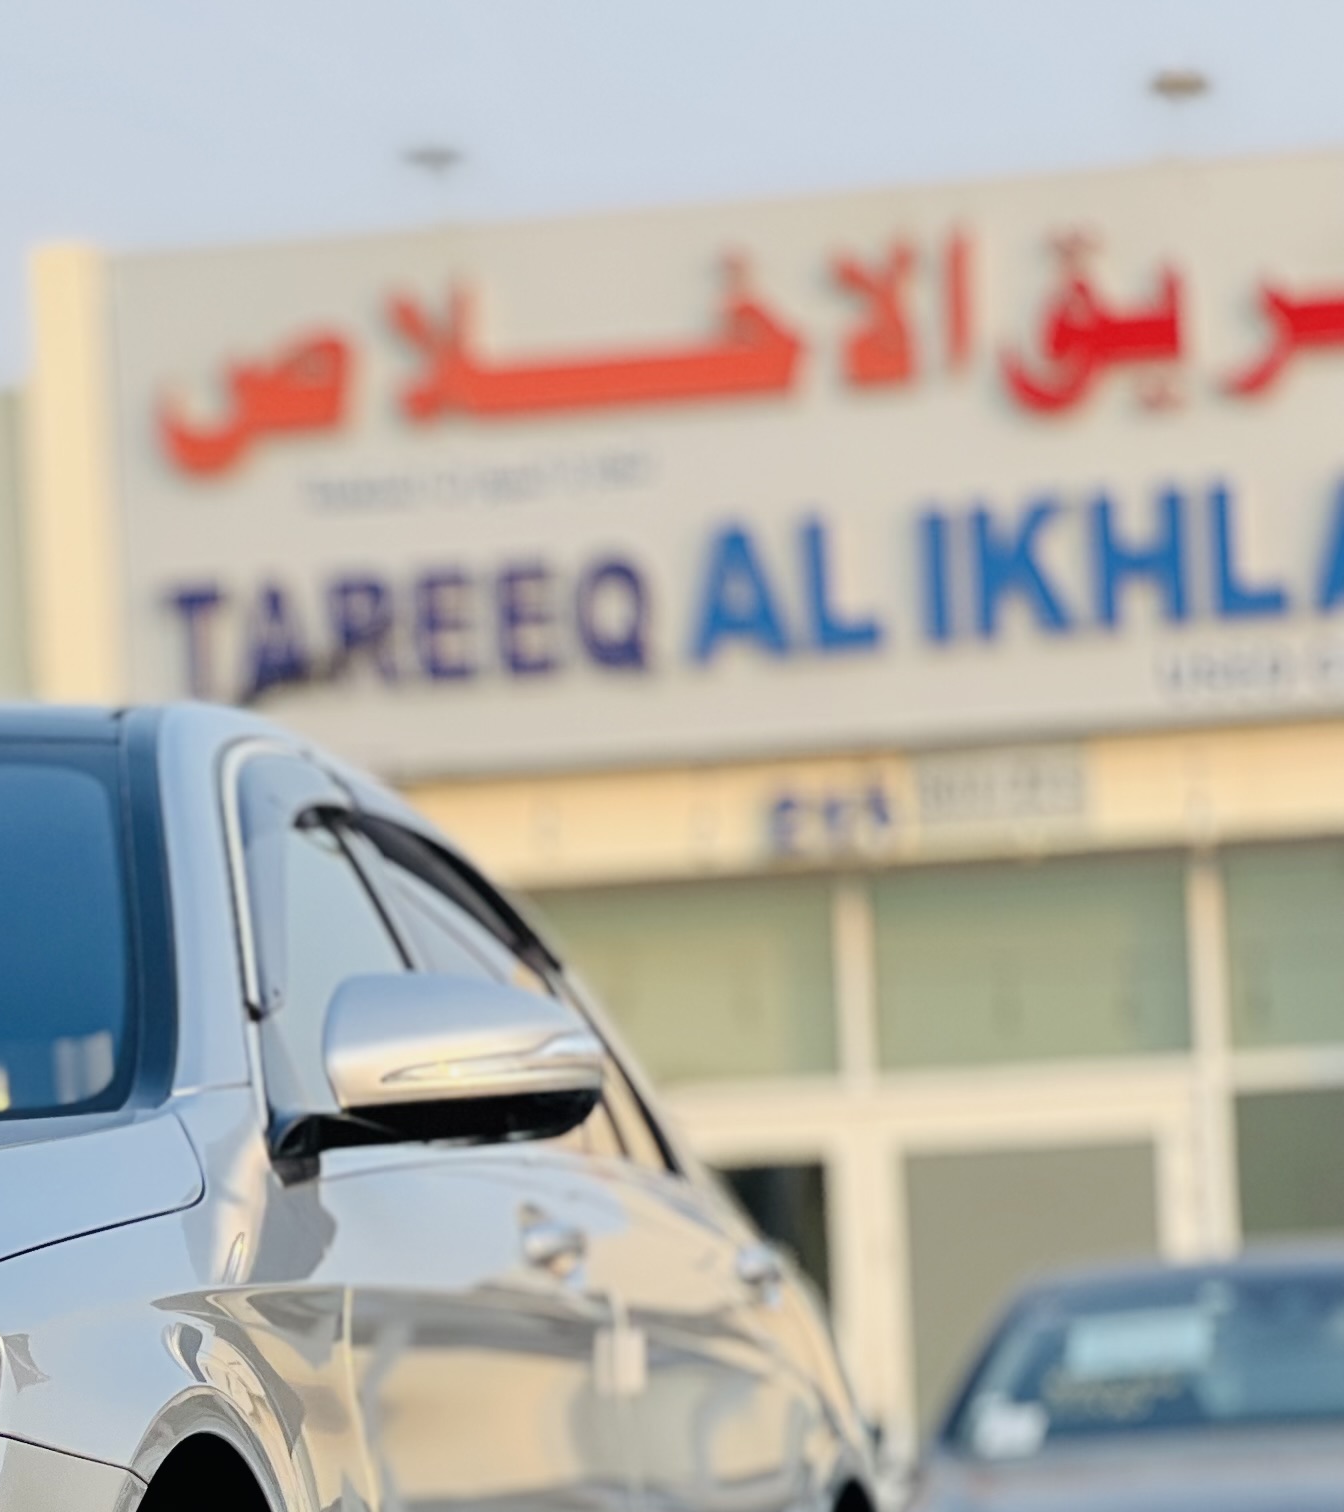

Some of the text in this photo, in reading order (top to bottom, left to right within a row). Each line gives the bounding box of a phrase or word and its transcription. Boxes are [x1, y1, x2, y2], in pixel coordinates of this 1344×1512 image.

[998, 226, 1344, 422] ريق
[164, 474, 1344, 702] TAREEQ AL IKHL
